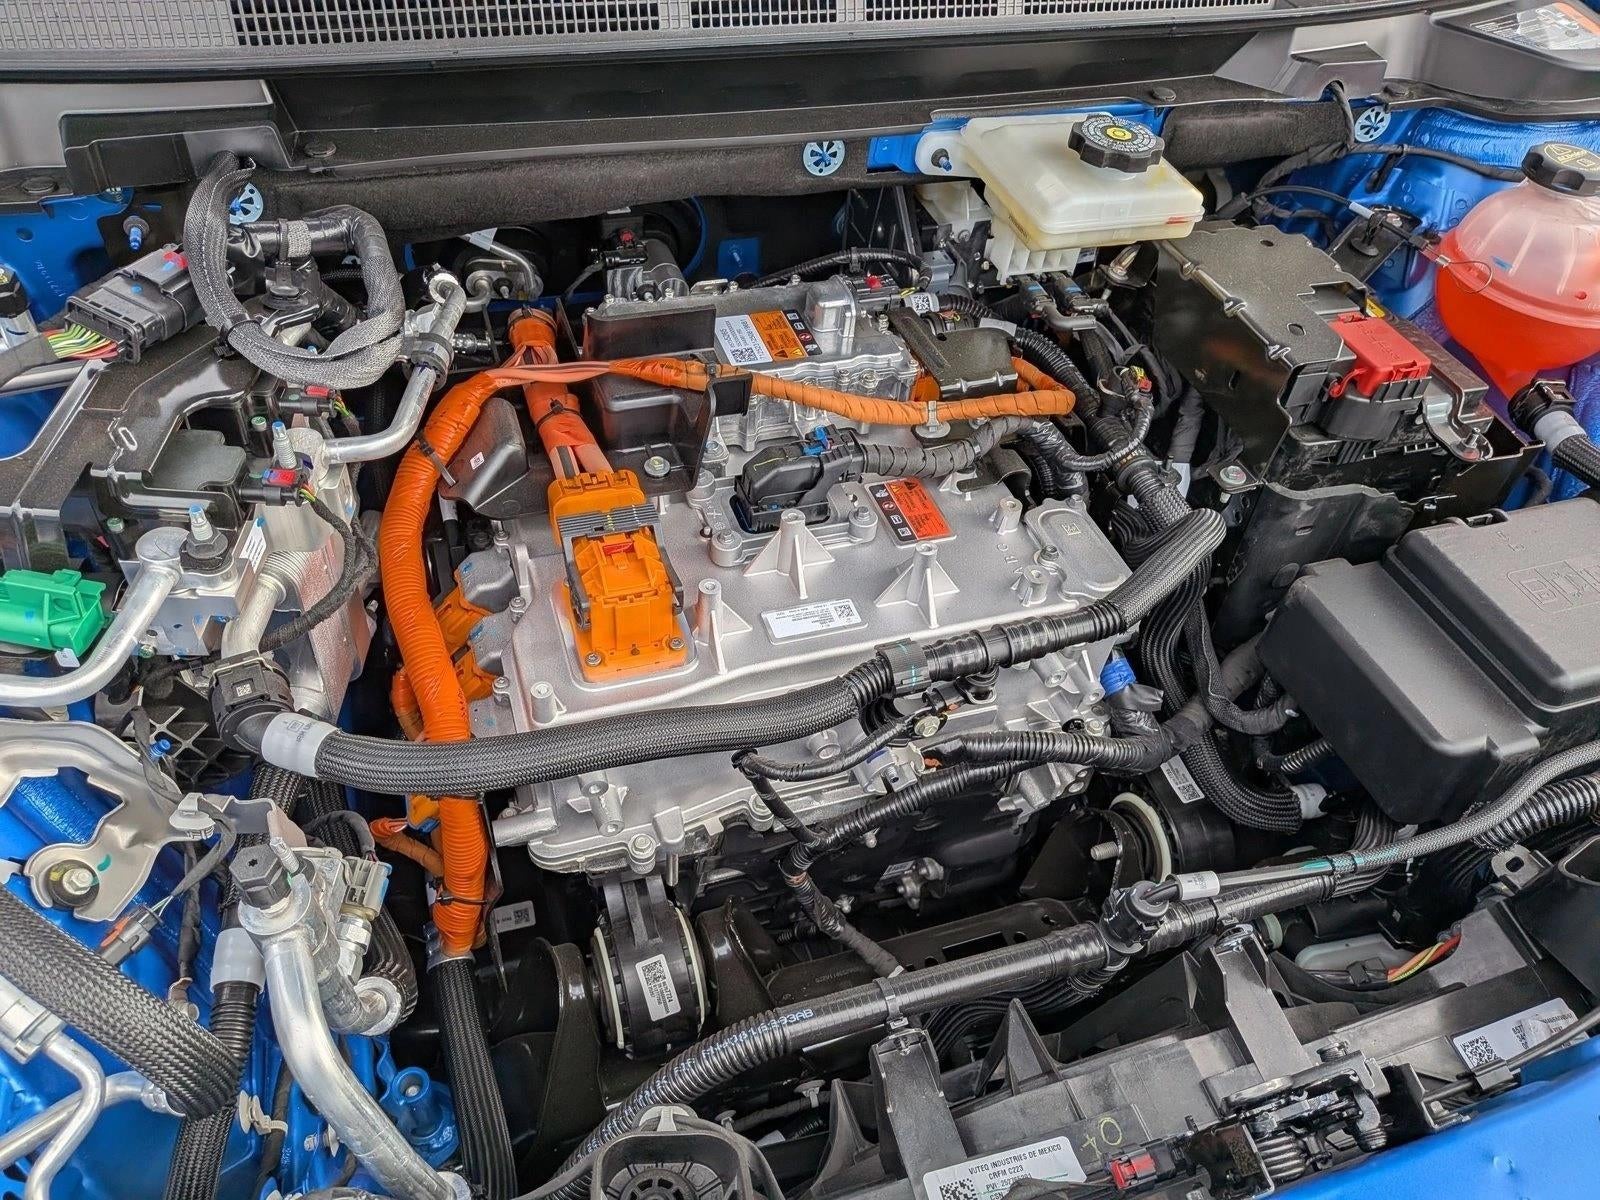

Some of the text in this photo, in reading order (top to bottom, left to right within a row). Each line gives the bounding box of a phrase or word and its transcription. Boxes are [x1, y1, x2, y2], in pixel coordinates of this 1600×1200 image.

[969, 1144, 1062, 1175] VUTEQ INDUSTRIES DE MEXICO
[988, 1165, 1024, 1180] CRFM C223
